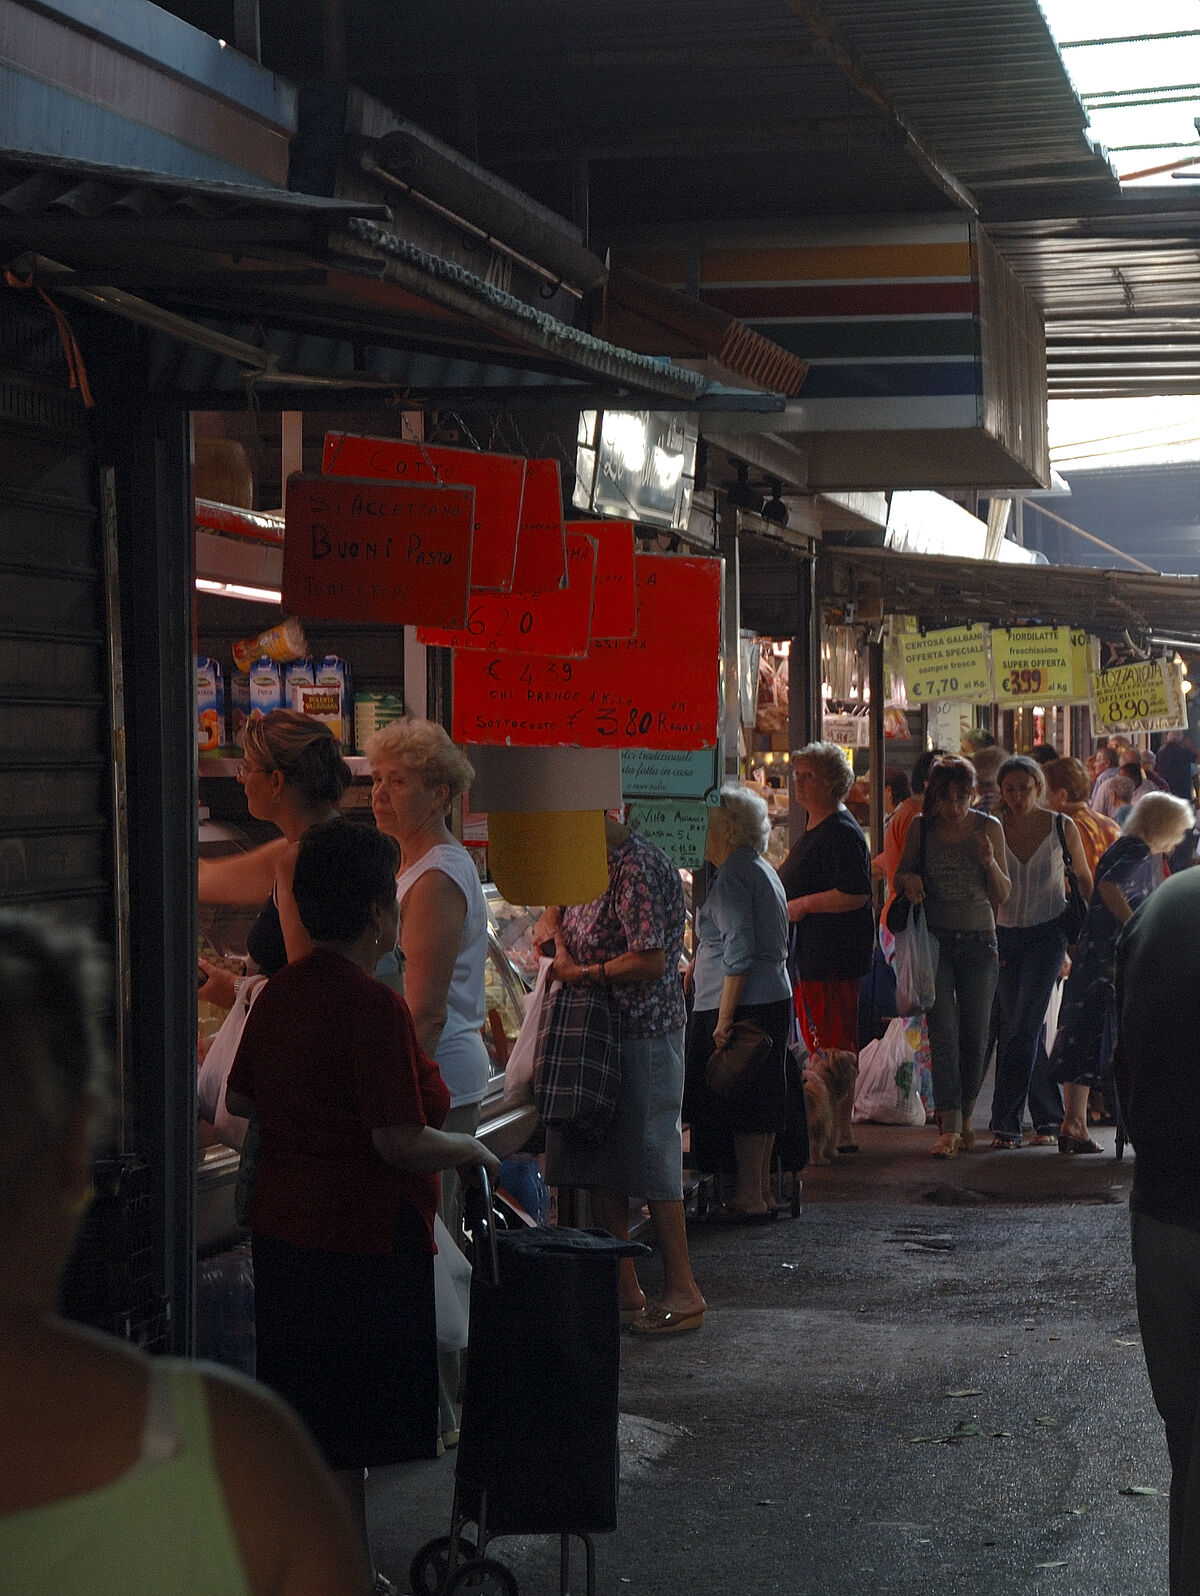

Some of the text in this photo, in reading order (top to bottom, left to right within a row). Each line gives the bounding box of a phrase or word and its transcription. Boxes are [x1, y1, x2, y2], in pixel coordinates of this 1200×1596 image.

[1008, 631, 1059, 641] FIORDILATTE
[906, 638, 944, 650] CERTOSA
[1009, 646, 1058, 655] freschissimo
[906, 645, 984, 663] OFFERTA SPECIALE
[919, 660, 976, 675] sempre fresca
[1002, 658, 1066, 669] SUPER OFFERTA
[912, 682, 922, 696] €
[926, 677, 959, 696] 7,70
[1002, 677, 1011, 692] €
[1048, 682, 1055, 691] al
[1057, 682, 1067, 692] Kg
